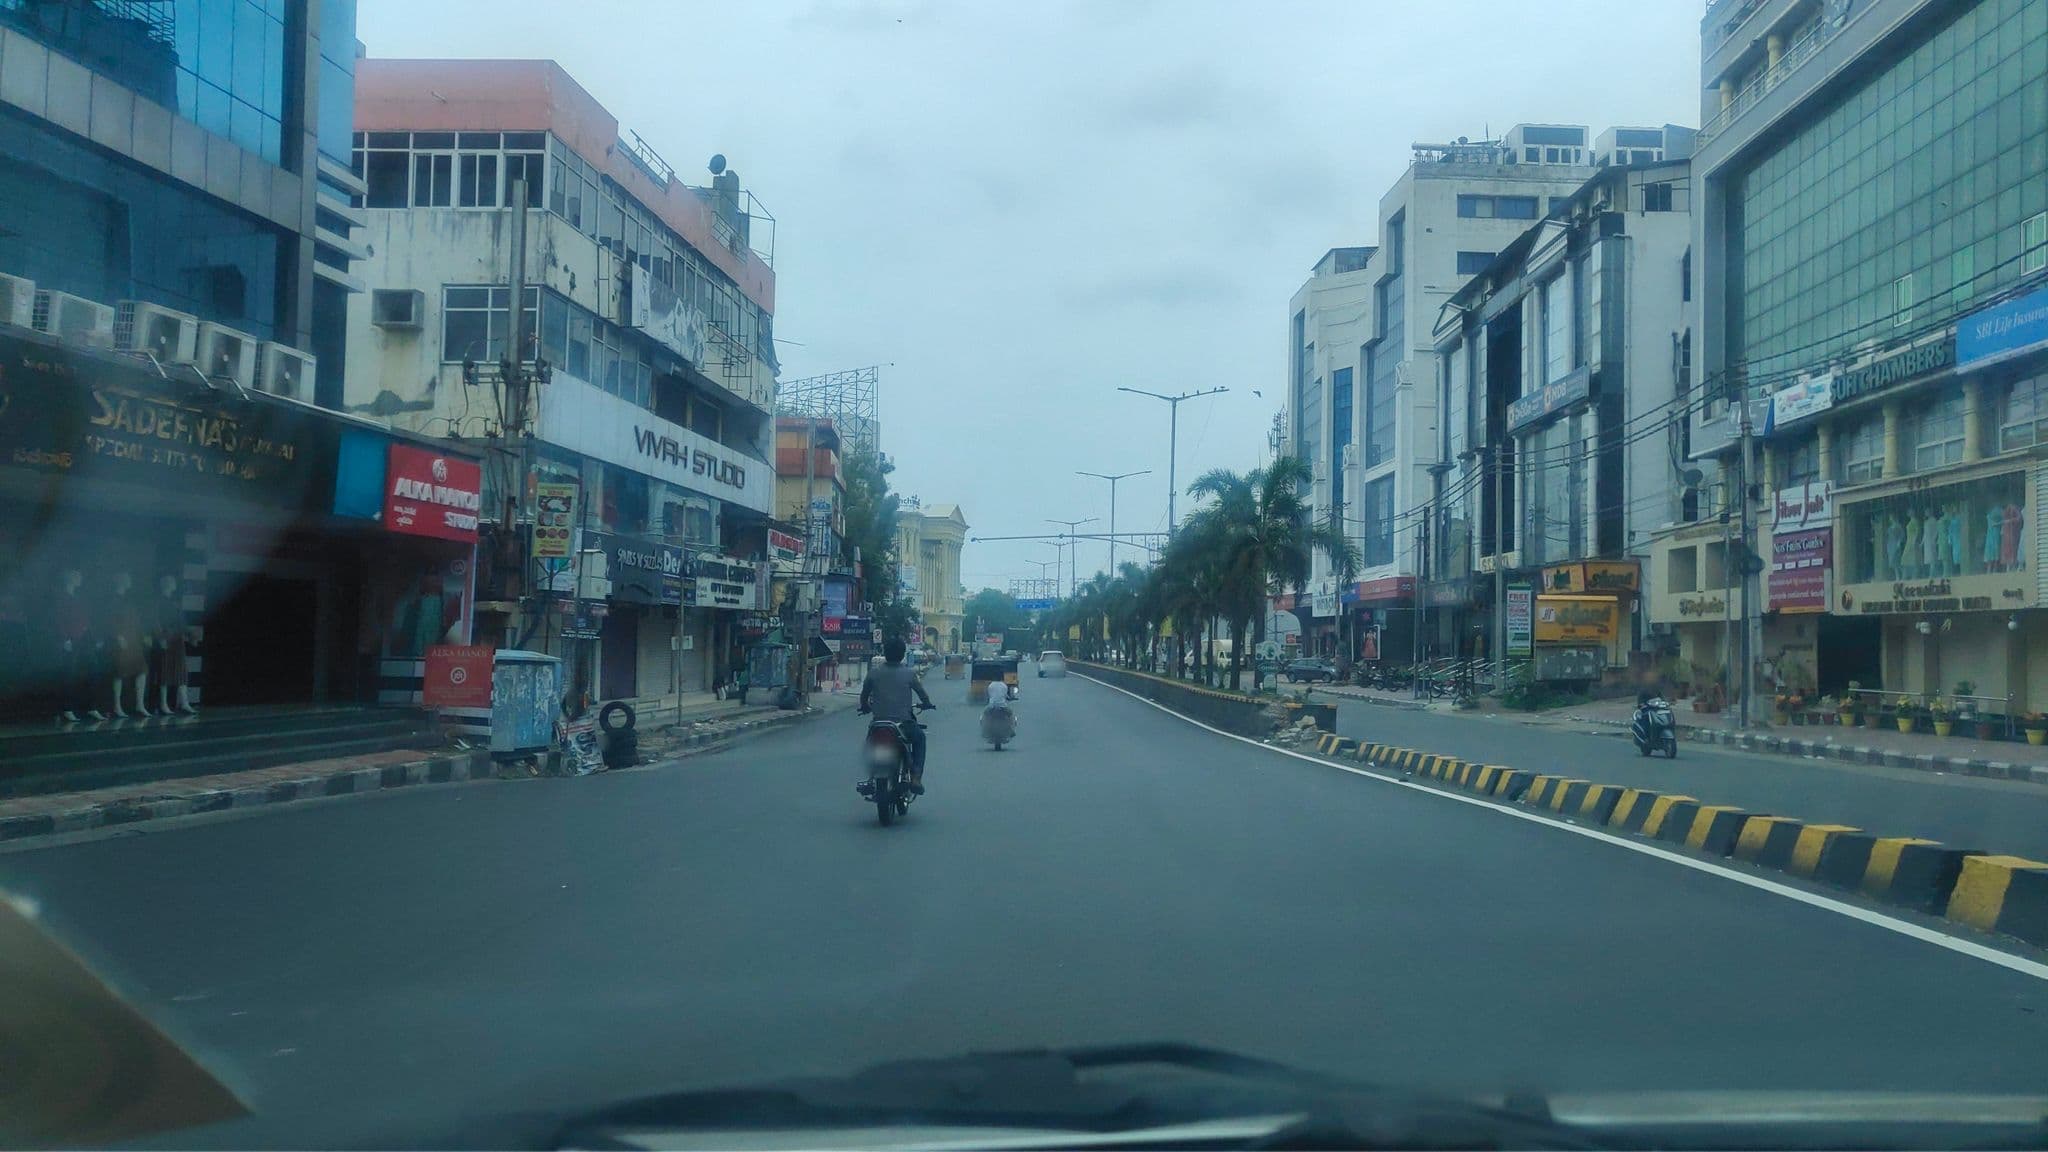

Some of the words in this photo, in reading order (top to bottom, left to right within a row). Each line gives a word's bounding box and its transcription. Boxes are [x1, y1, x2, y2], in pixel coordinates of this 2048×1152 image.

[1976, 320, 1993, 339] SBI
[1994, 315, 2013, 337] Life
[1859, 344, 1948, 392] CHAMBERS
[634, 425, 688, 469] VIVAH
[693, 450, 746, 490] STUDIO
